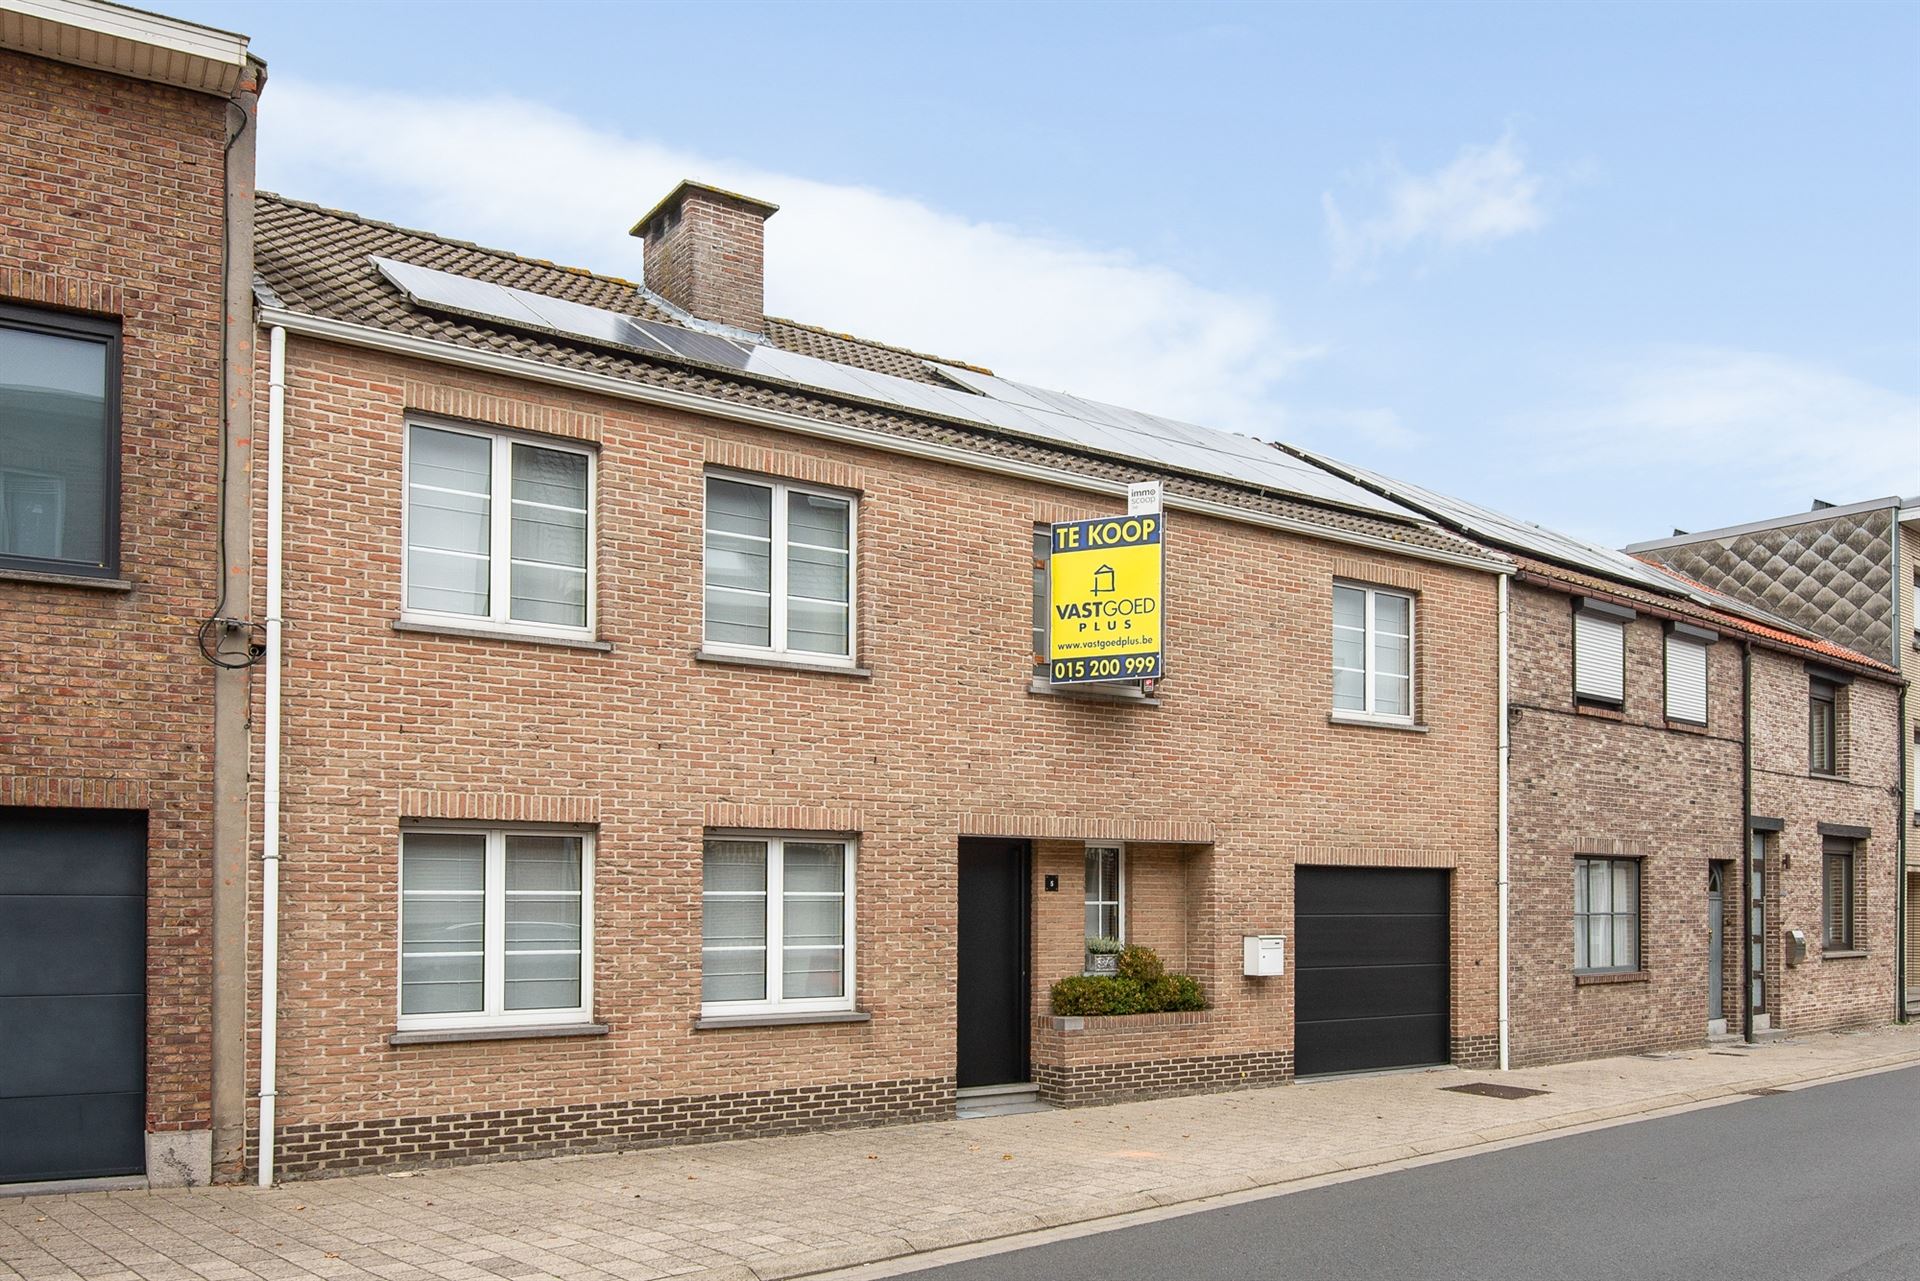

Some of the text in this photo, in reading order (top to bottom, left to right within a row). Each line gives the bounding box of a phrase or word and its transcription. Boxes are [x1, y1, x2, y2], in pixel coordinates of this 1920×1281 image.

[1131, 489, 1156, 498] immo
[1131, 496, 1156, 505] scoop
[1056, 519, 1156, 549] TE KOOP
[1056, 597, 1156, 620] VASTGOED
[1079, 619, 1132, 632] PLUS
[1057, 635, 1153, 650] www.vastgoedplus.be
[1055, 656, 1155, 679] 015 200 999
